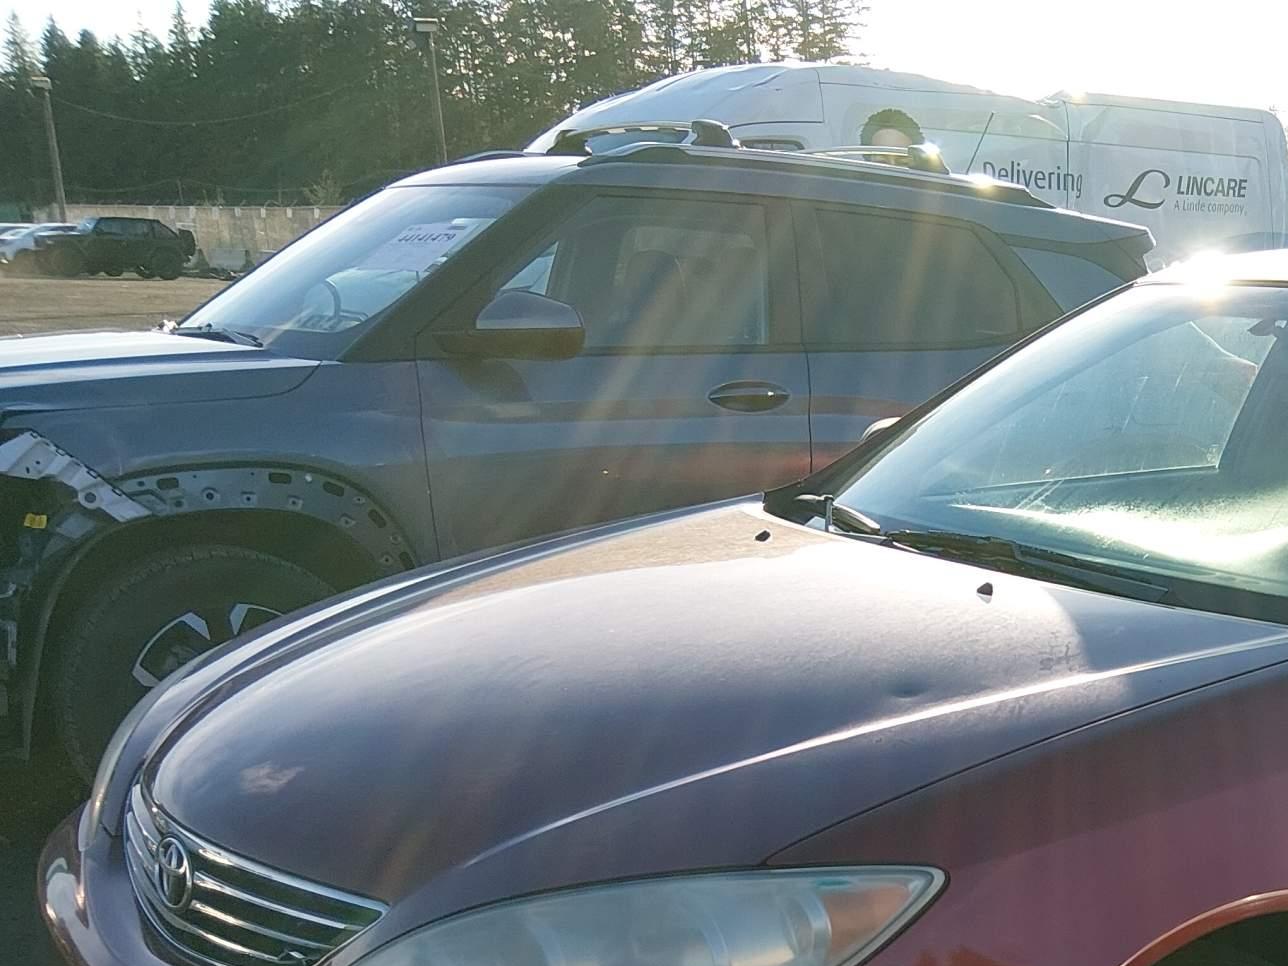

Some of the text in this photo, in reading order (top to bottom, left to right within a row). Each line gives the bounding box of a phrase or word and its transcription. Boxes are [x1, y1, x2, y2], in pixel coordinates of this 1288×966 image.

[983, 161, 1082, 198] Delivering
[1177, 175, 1248, 198] LINCARE
[1174, 200, 1180, 210] A
[1183, 199, 1204, 212] Linde
